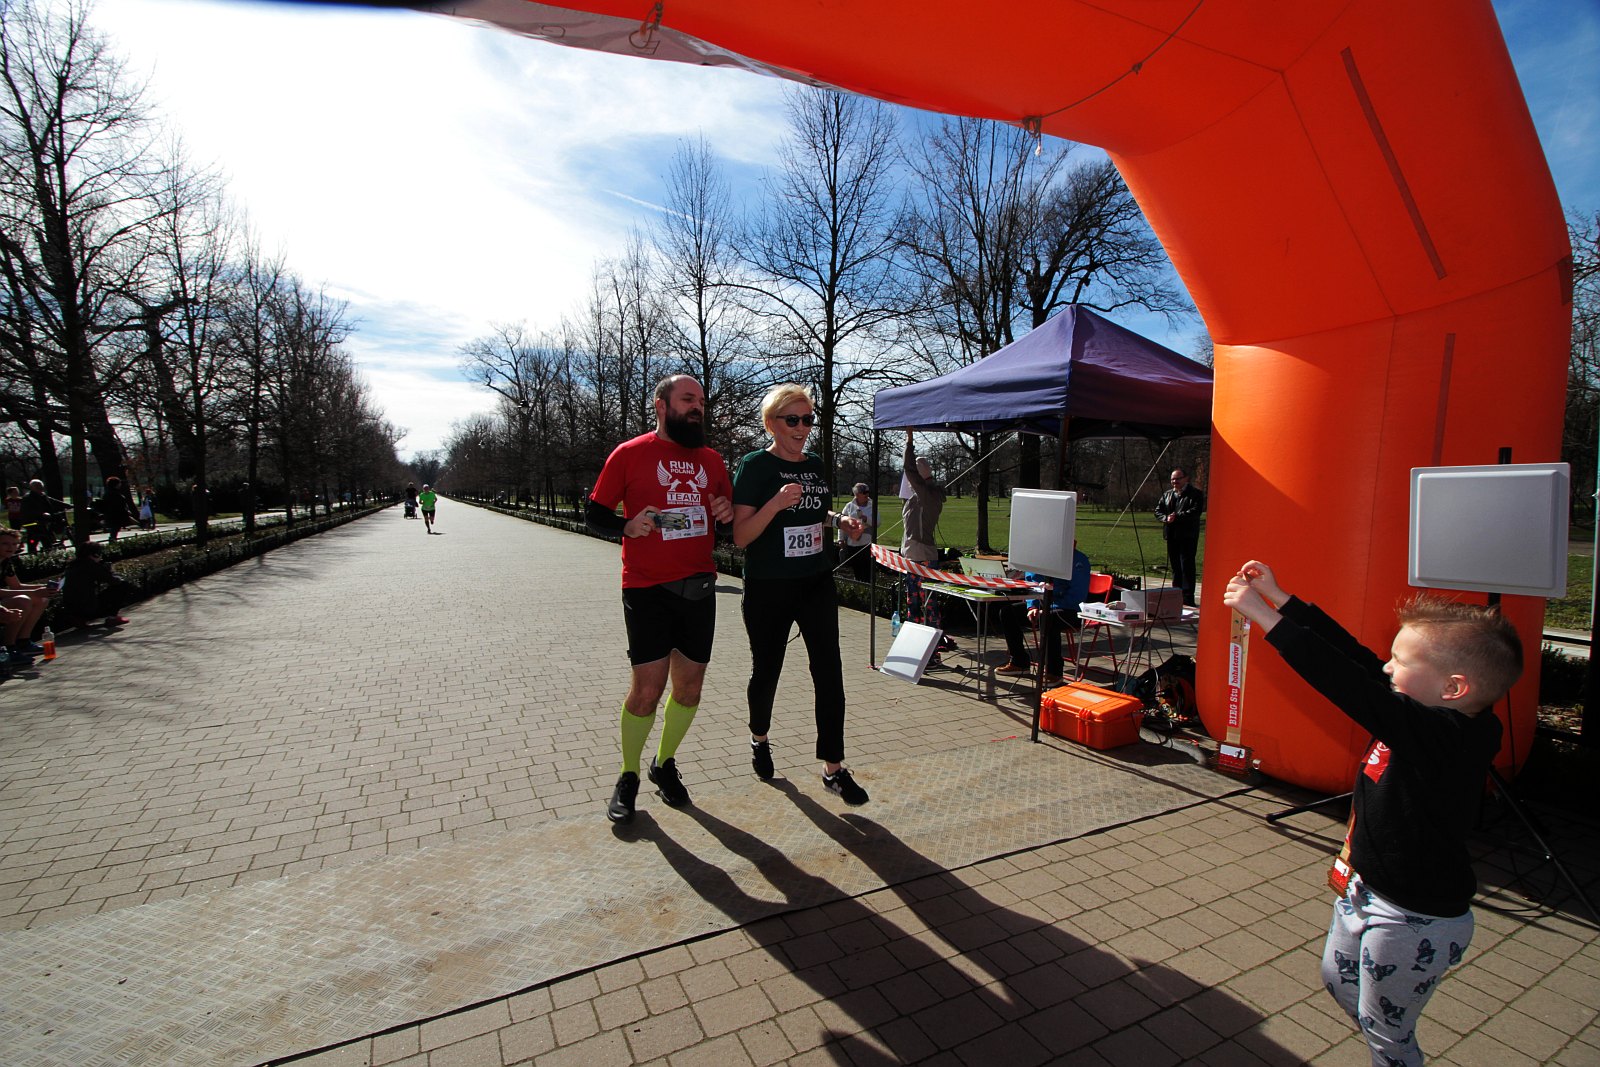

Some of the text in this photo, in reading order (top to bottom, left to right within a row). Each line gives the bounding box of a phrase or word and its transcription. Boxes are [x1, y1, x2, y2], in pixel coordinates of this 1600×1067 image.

[669, 460, 694, 470] RUN
[668, 492, 700, 502] TEAM
[788, 533, 812, 549] 283
[1230, 688, 1238, 703] Stu
[1229, 704, 1238, 726] BIEG
